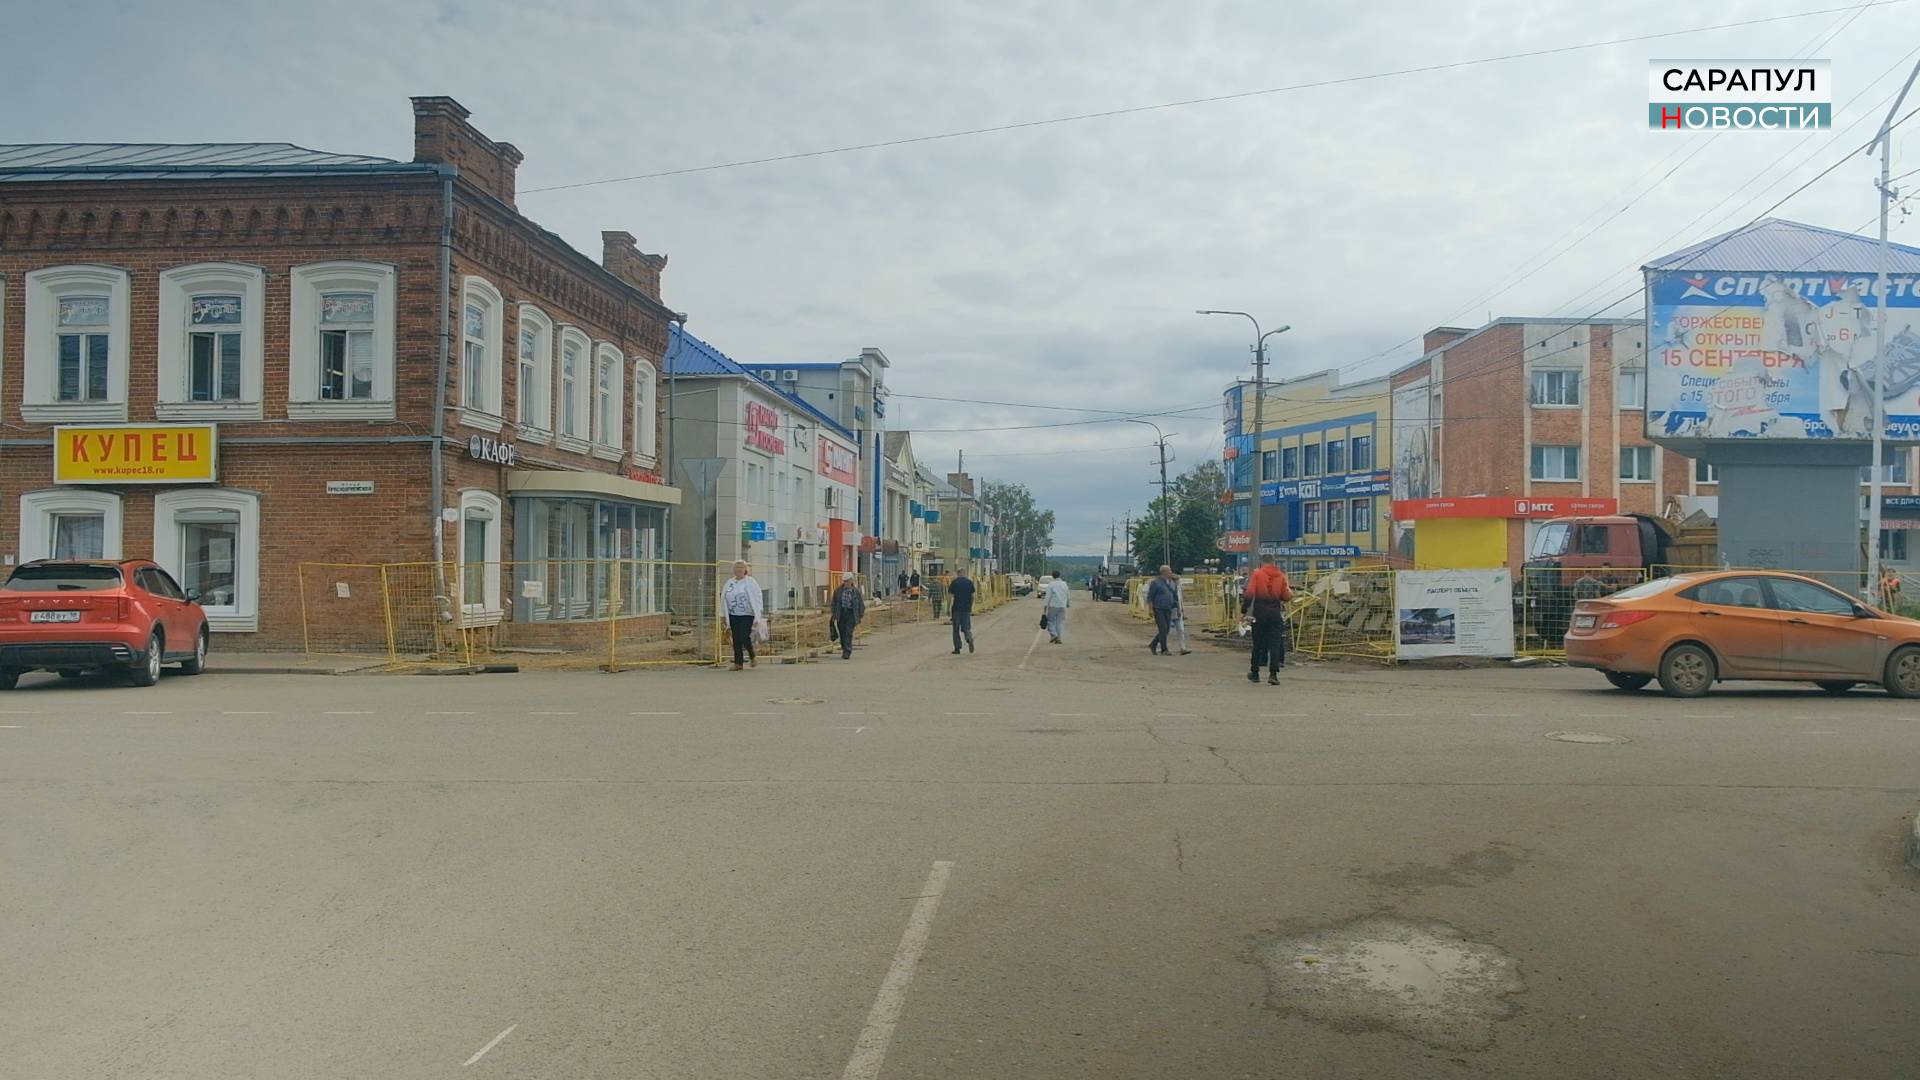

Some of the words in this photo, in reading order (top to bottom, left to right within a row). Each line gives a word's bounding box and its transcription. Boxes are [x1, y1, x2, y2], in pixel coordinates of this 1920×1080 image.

[1672, 316, 1765, 329] ТОРЖЕСТВЕ
[1660, 349, 1682, 367] 15
[1691, 390, 1703, 402] 15
[72, 433, 198, 463] КУПЕЦ
[481, 437, 515, 466] КАФЕ
[93, 465, 165, 476] www.kupec18.ru
[1531, 503, 1555, 512] МТС
